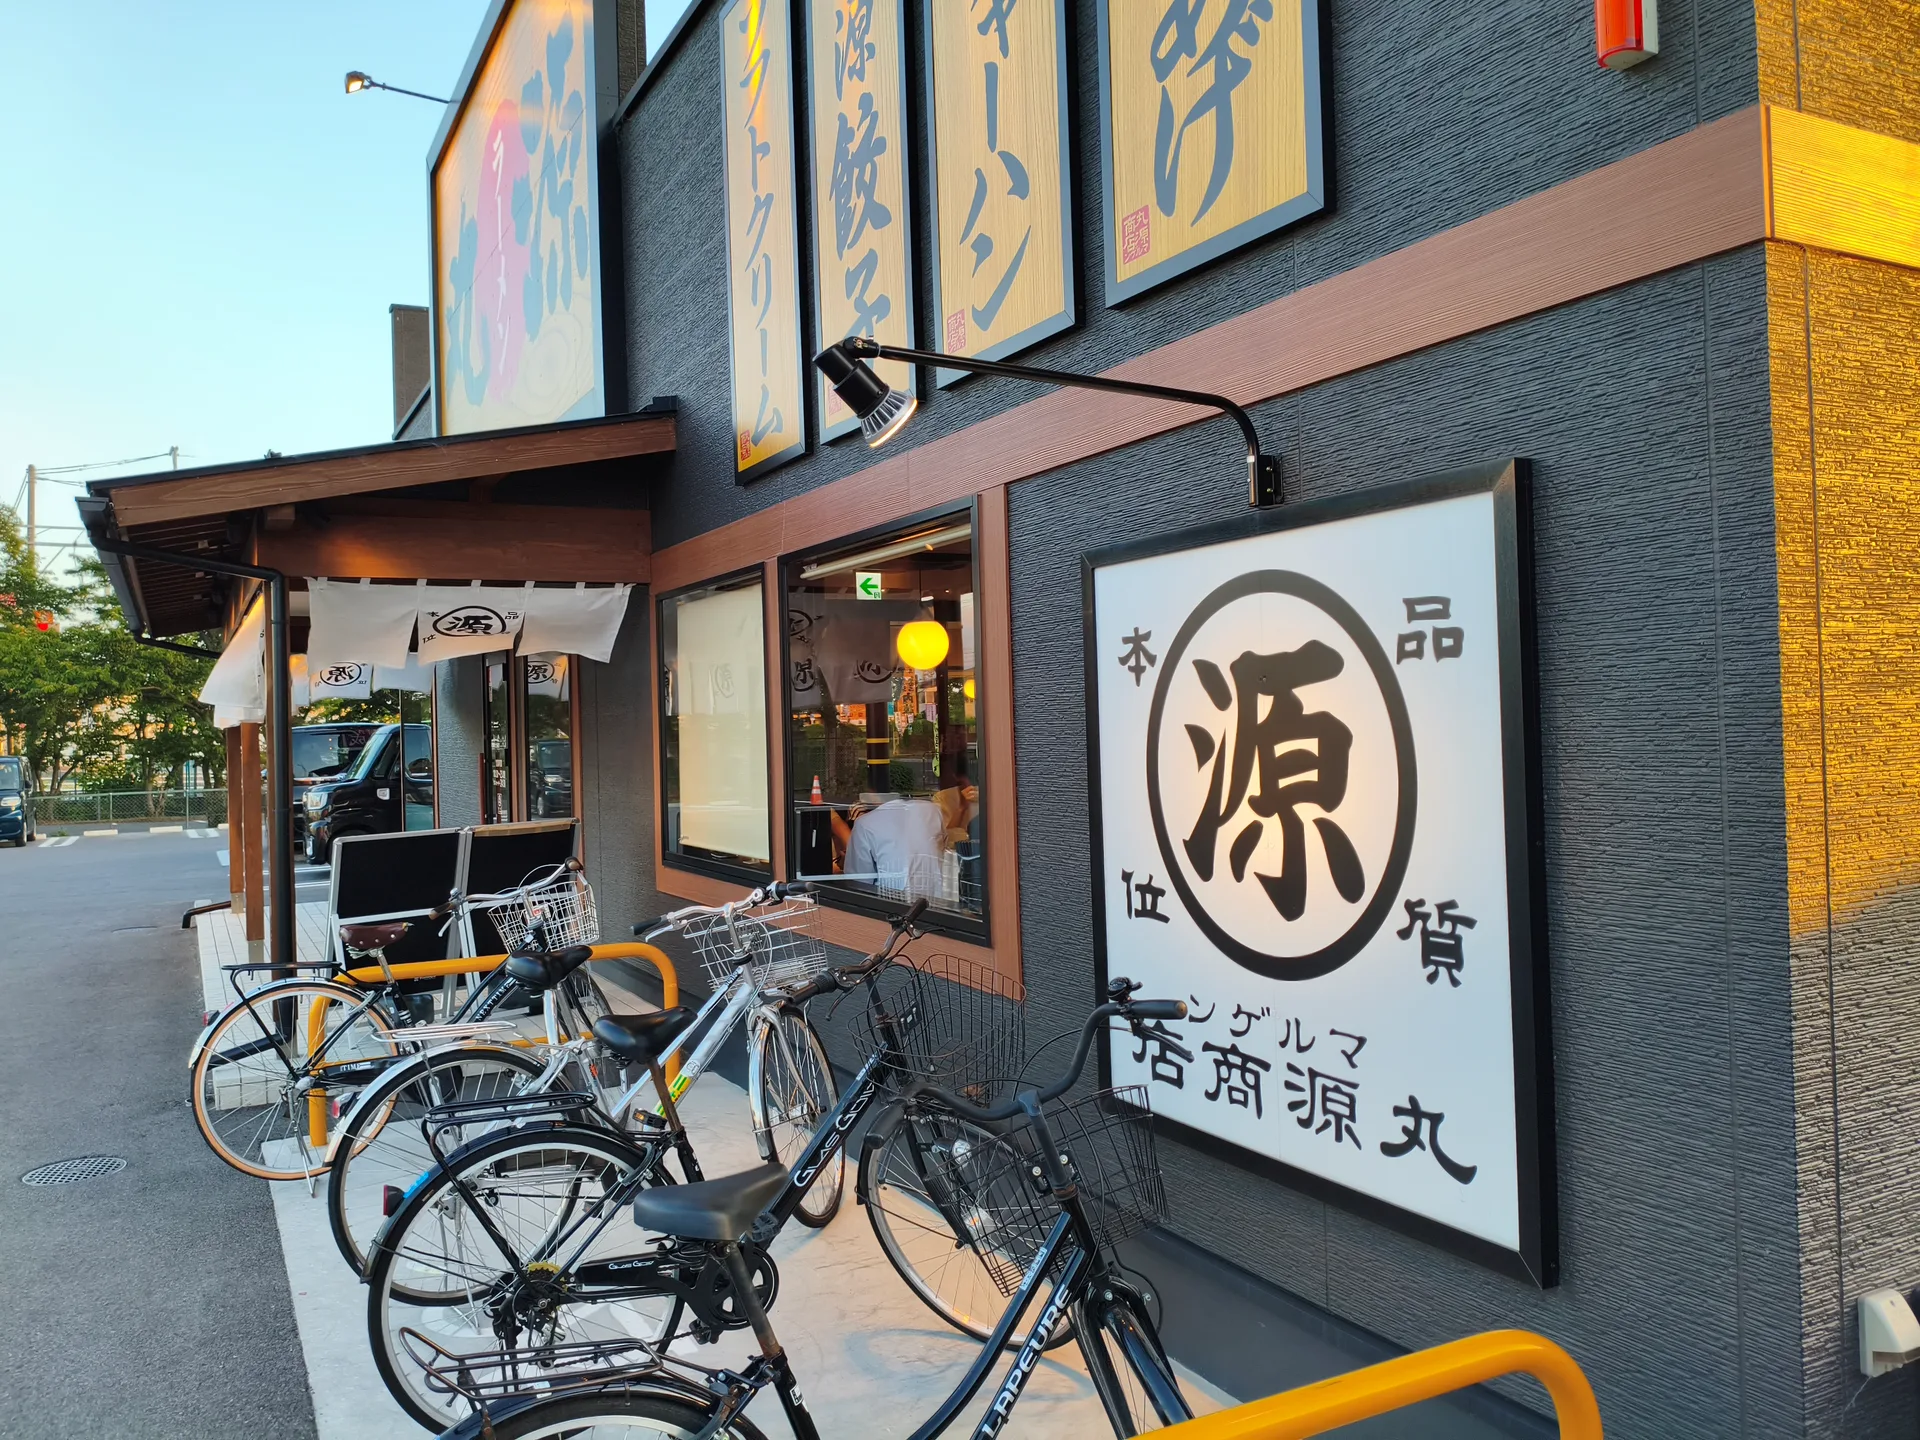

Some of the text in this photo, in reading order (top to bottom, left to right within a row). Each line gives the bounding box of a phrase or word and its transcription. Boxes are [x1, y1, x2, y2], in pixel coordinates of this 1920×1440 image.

[492, 130, 511, 376] ラーメン
[959, 0, 1031, 332] ャーハン
[1183, 639, 1366, 922] 源
[982, 1284, 1072, 1439] LAPEURE
